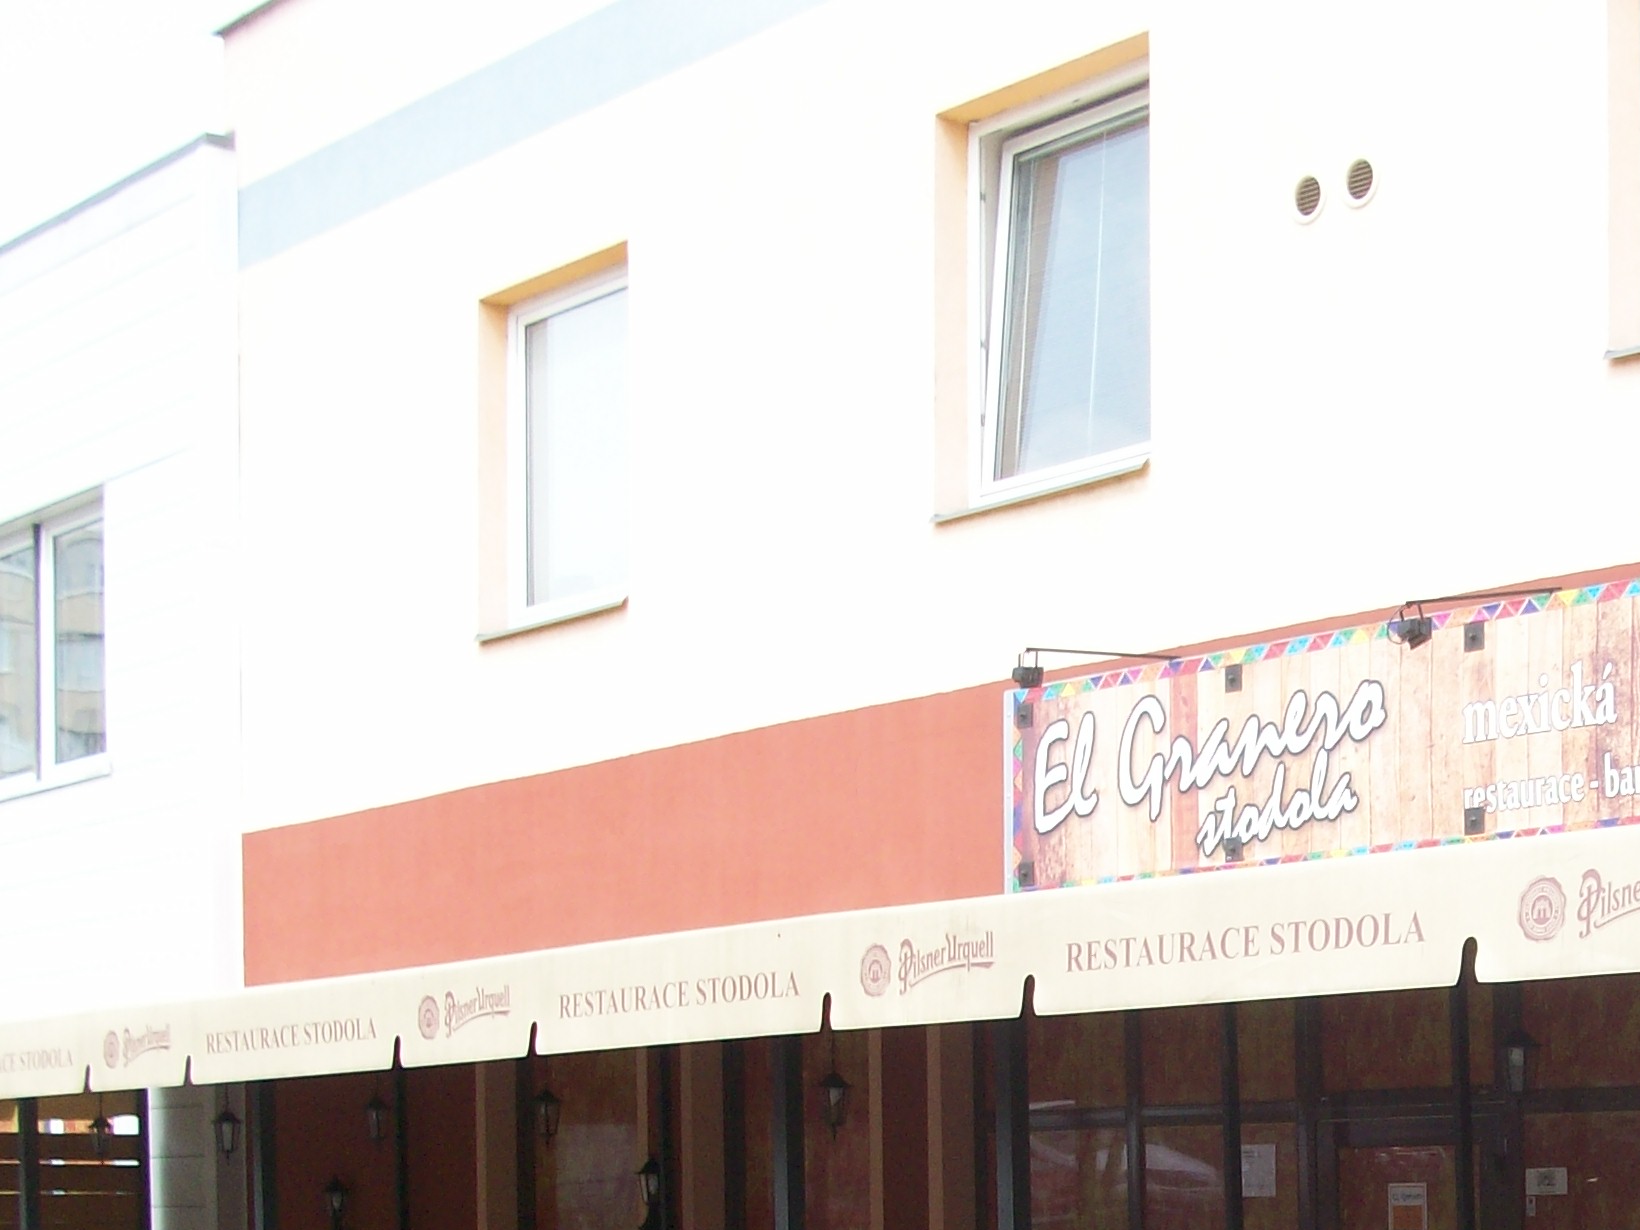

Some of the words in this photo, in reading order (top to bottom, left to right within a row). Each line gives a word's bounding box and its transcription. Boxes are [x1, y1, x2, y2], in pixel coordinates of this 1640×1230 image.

[1462, 660, 1618, 744] mexická
[1034, 711, 1099, 833] El
[1118, 679, 1387, 822] Granero
[1196, 747, 1359, 856] stodola
[1464, 772, 1586, 813] restaurace
[899, 939, 947, 995] Pilsner
[947, 931, 994, 973] Urquell
[1065, 925, 1260, 973] RESTAURACE
[1270, 910, 1426, 955] STODOLA
[444, 990, 478, 1038] Pilsner
[477, 985, 511, 1018] Urquell
[558, 981, 690, 1019] RESTAURACE
[696, 971, 800, 1006] STODOLA
[20, 1048, 74, 1072] STODOLA
[206, 1023, 299, 1054] RESTAURACE
[304, 1017, 378, 1044] STODOLA
